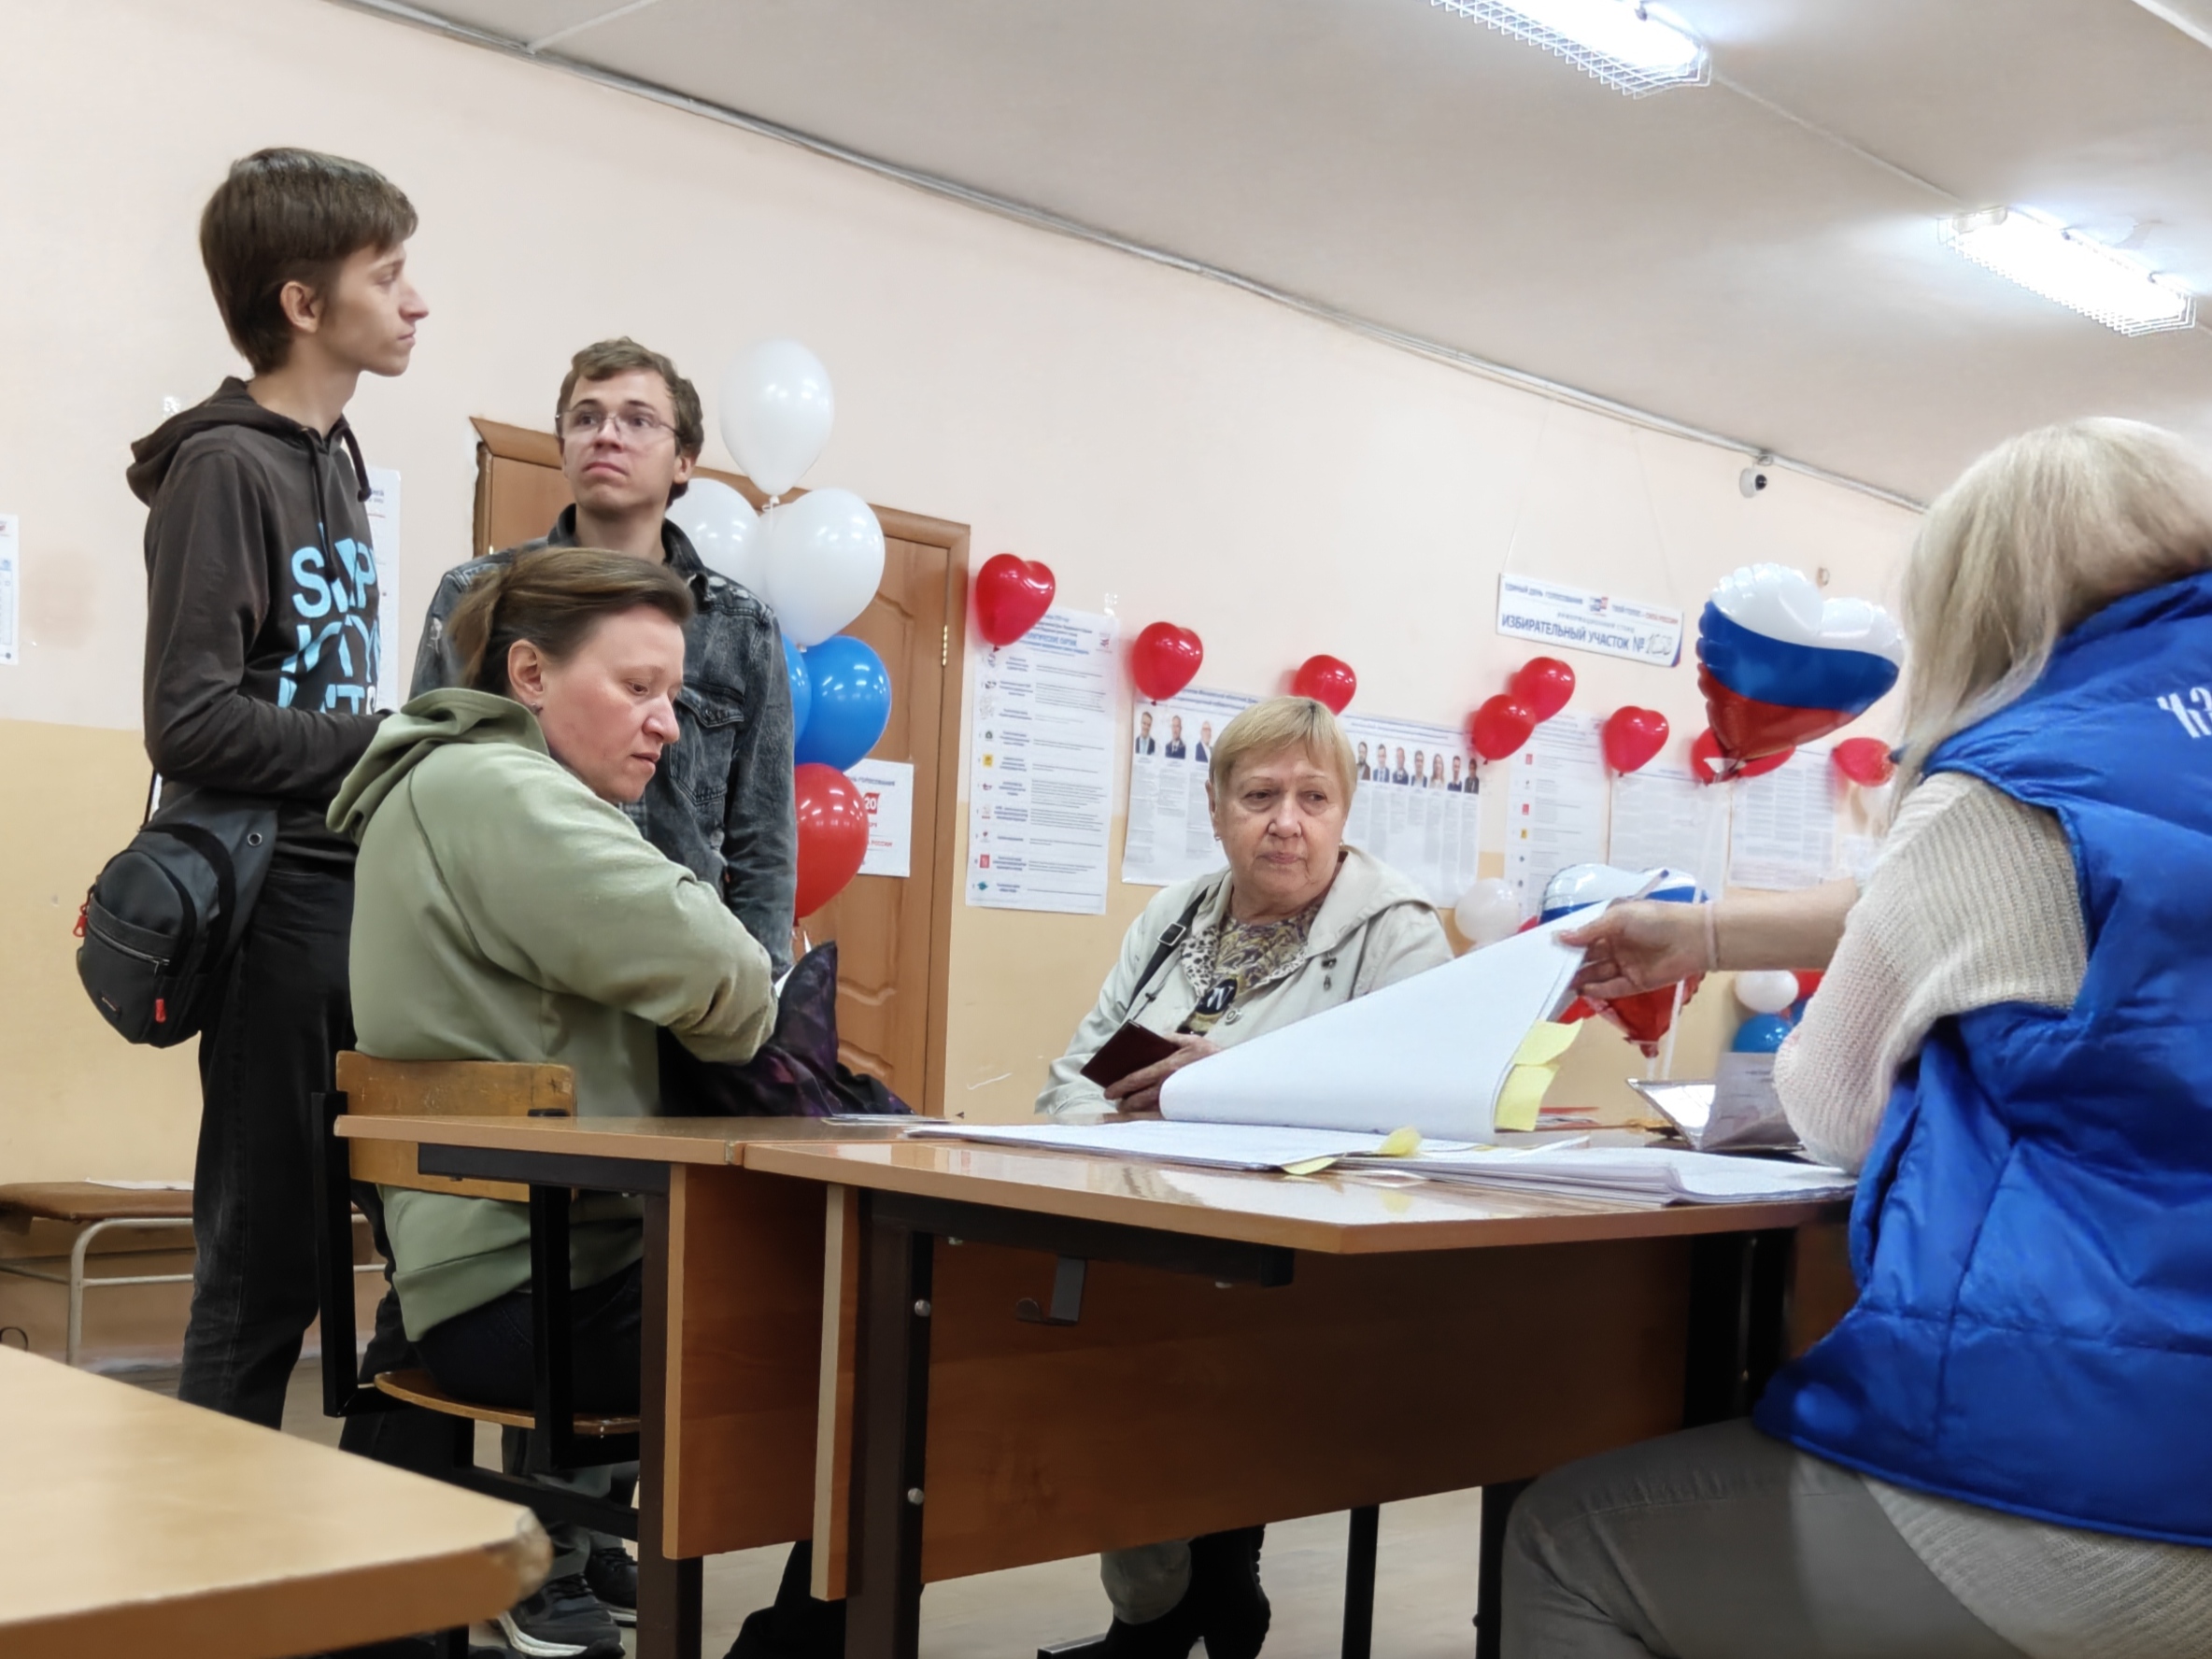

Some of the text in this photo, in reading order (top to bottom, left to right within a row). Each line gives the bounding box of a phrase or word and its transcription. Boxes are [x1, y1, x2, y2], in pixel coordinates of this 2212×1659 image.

[1502, 614, 1586, 641] ИЗБИРАТЕЛЬНЫЙ
[1588, 631, 1630, 651] УЧАСТОК
[864, 797, 877, 811] 20
